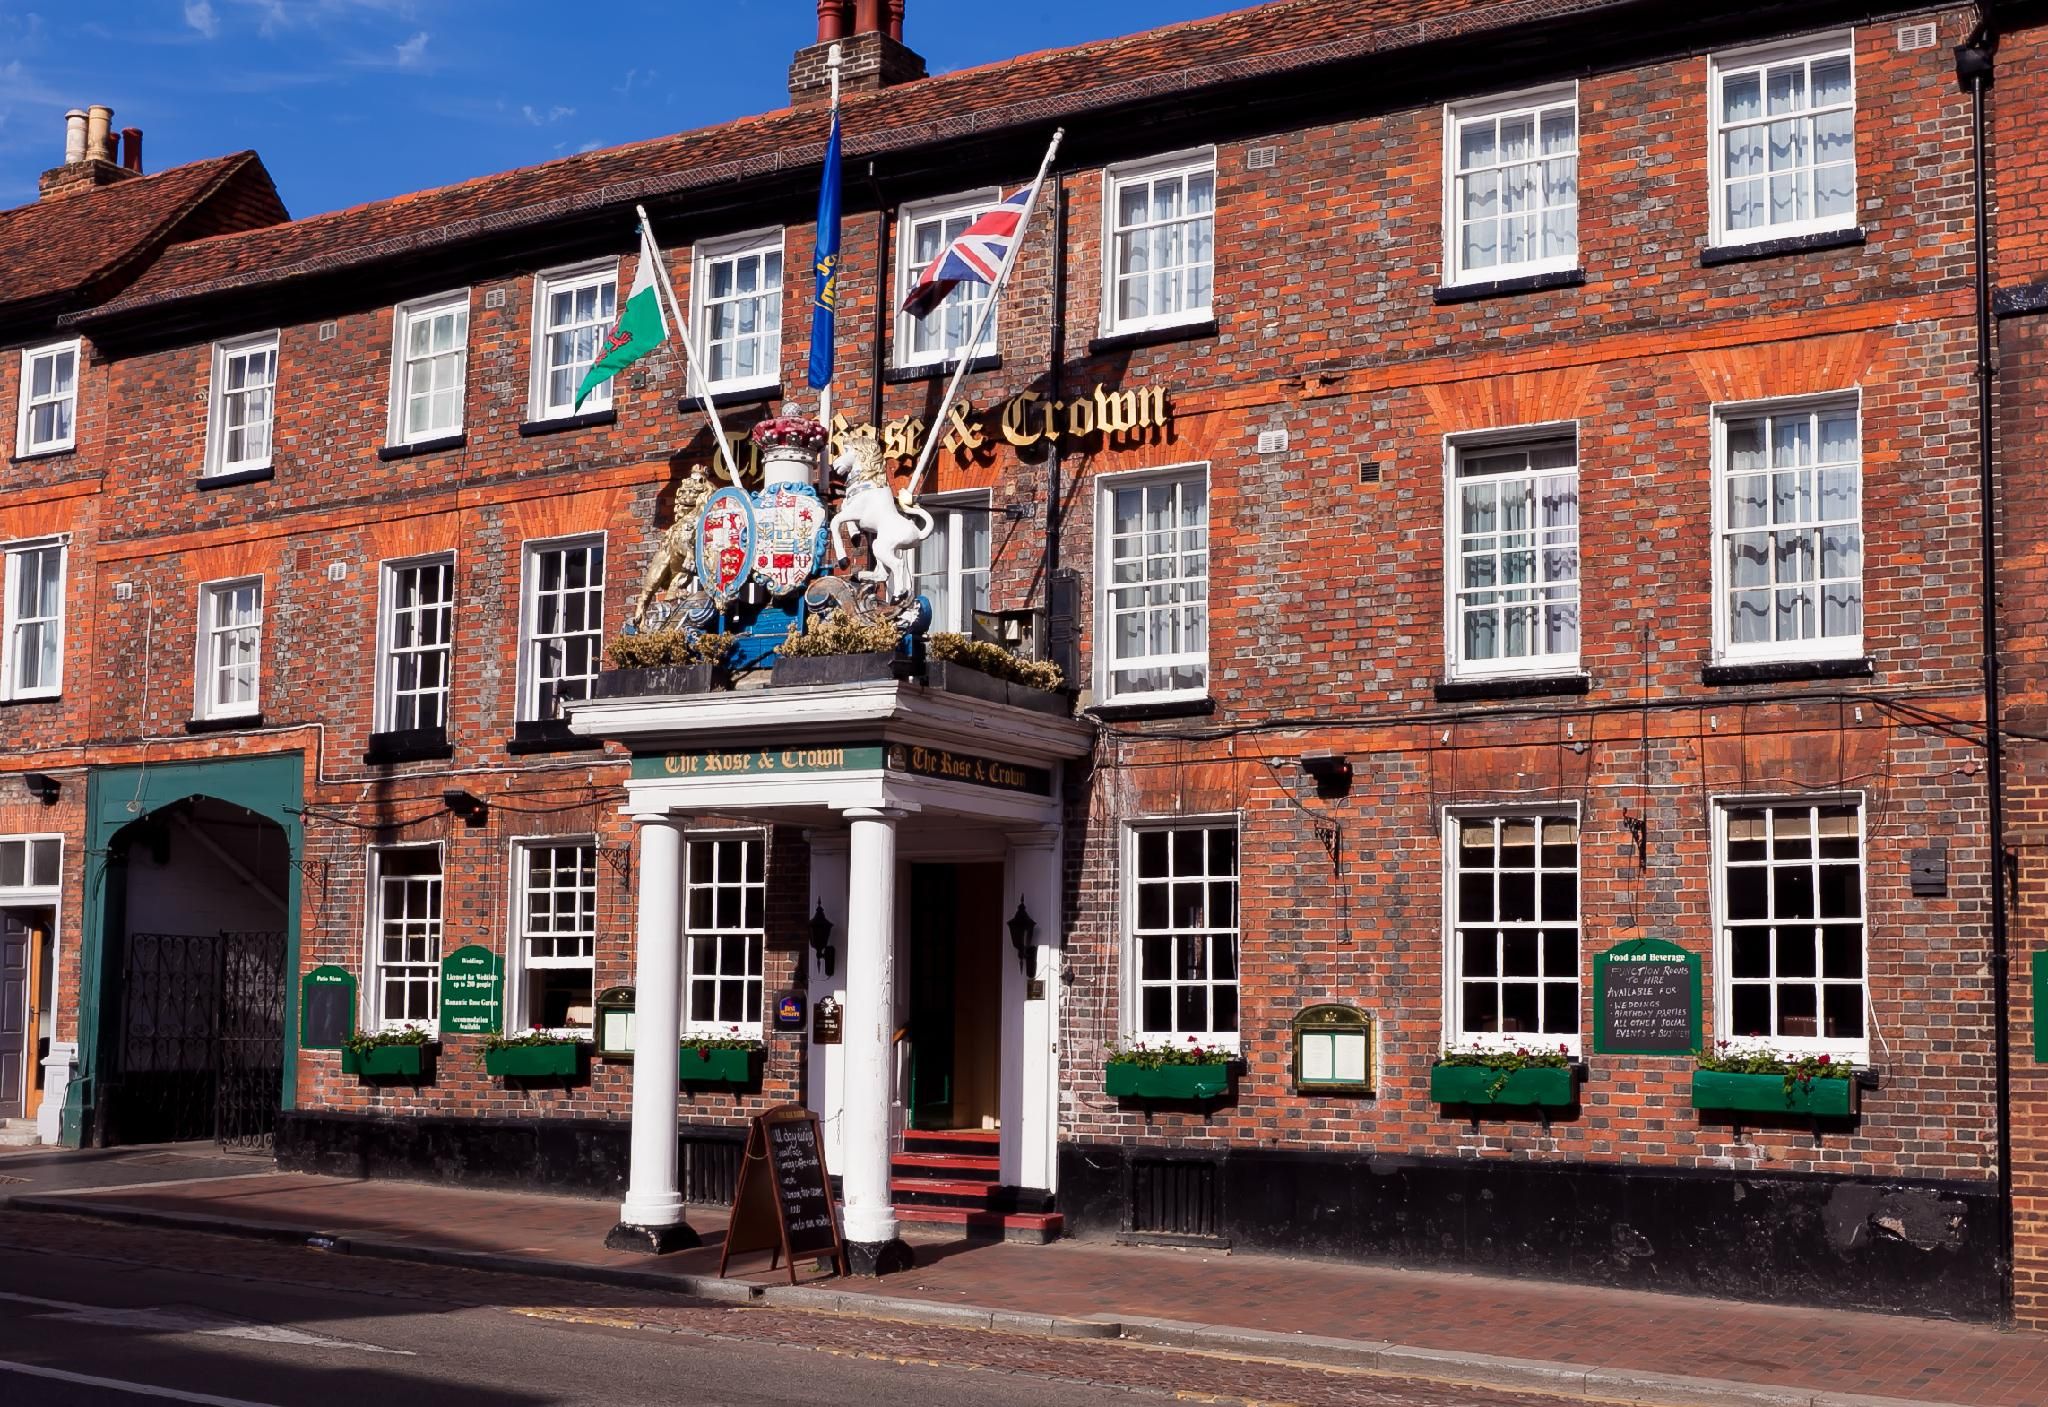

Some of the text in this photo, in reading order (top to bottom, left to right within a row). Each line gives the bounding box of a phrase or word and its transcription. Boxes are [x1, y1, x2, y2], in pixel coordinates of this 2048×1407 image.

[943, 399, 984, 455] &
[1002, 383, 1168, 446] Crown
[665, 745, 844, 775] The Rose & Crown
[912, 746, 1026, 786] The Rose & Crown
[1609, 953, 1686, 963] Food and Beverage
[1626, 976, 1664, 985] TO HIRE
[1607, 986, 1677, 998] AVAILABLE FOR
[1614, 1000, 1660, 1010] WEDDINGS
[1614, 1008, 1687, 1018] BIRTHDAY PARTIES
[1614, 1018, 1686, 1028] ALL OTHER SOCIAL
[1615, 1028, 1646, 1038] EVENTS
